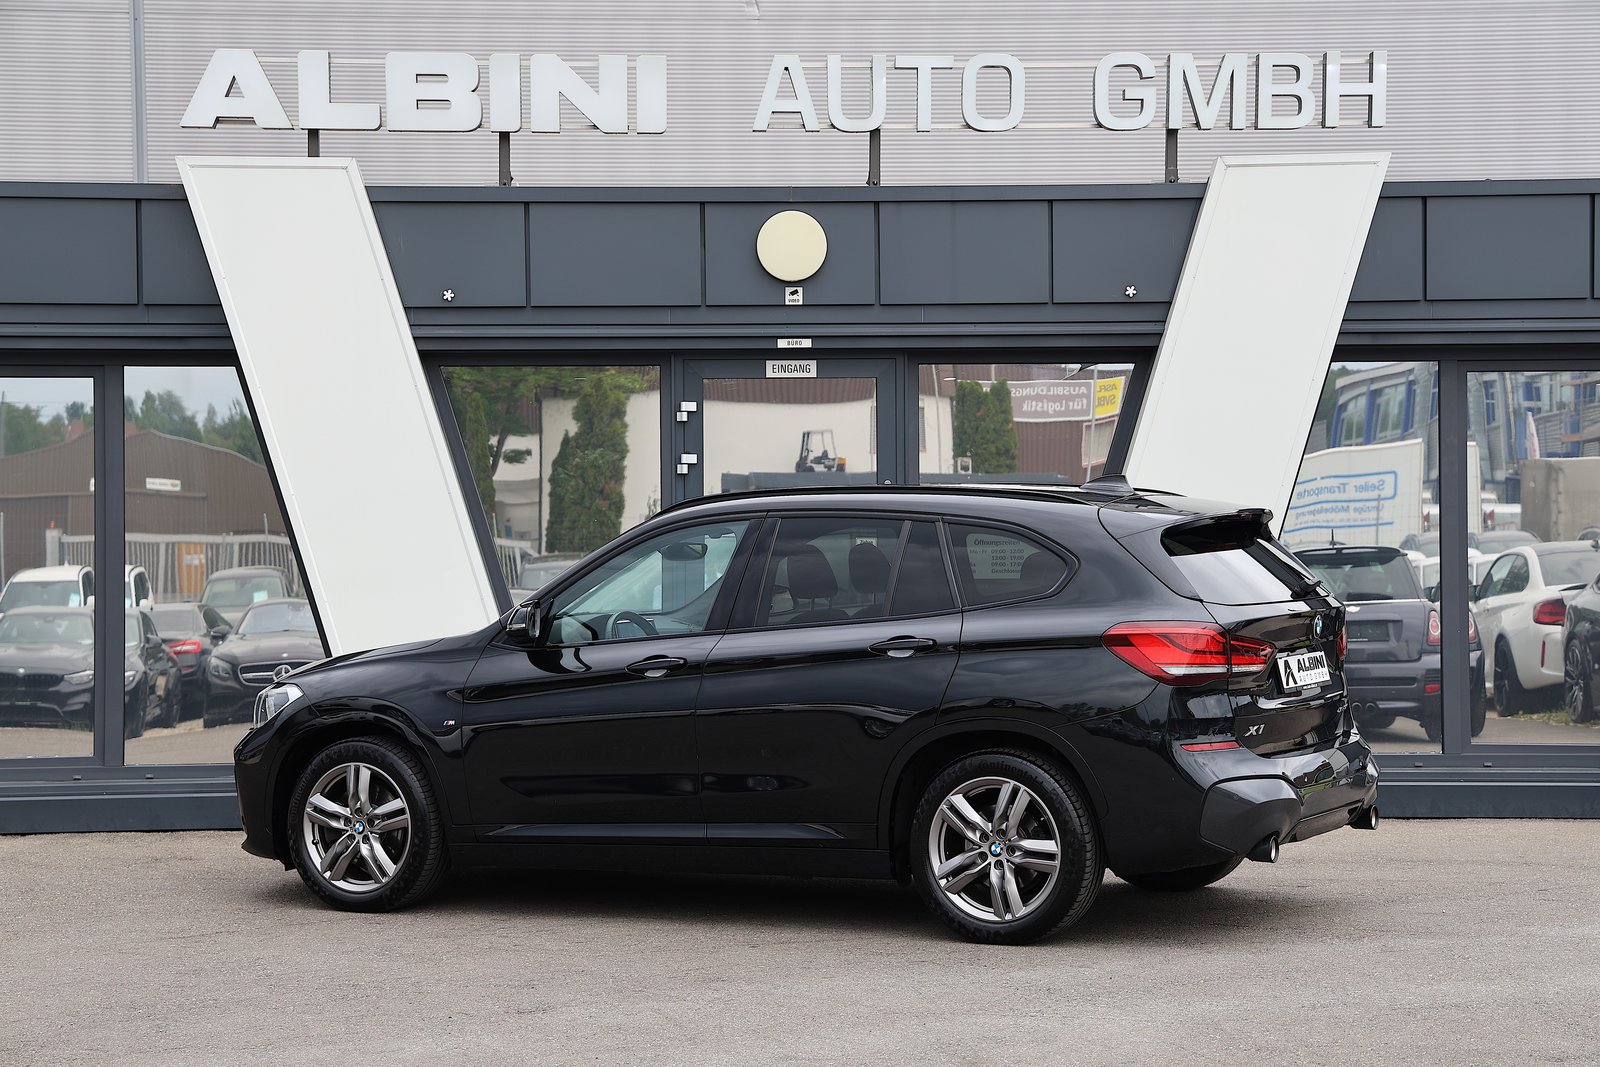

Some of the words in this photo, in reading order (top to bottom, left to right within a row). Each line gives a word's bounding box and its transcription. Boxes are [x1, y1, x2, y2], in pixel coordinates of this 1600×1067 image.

[180, 48, 668, 134] ALBINI
[752, 53, 1026, 133] AUTO
[1093, 50, 1388, 131] GMBH
[771, 363, 811, 374] EINGANG
[1297, 654, 1326, 673] ALBINI
[1244, 724, 1265, 737] X1
